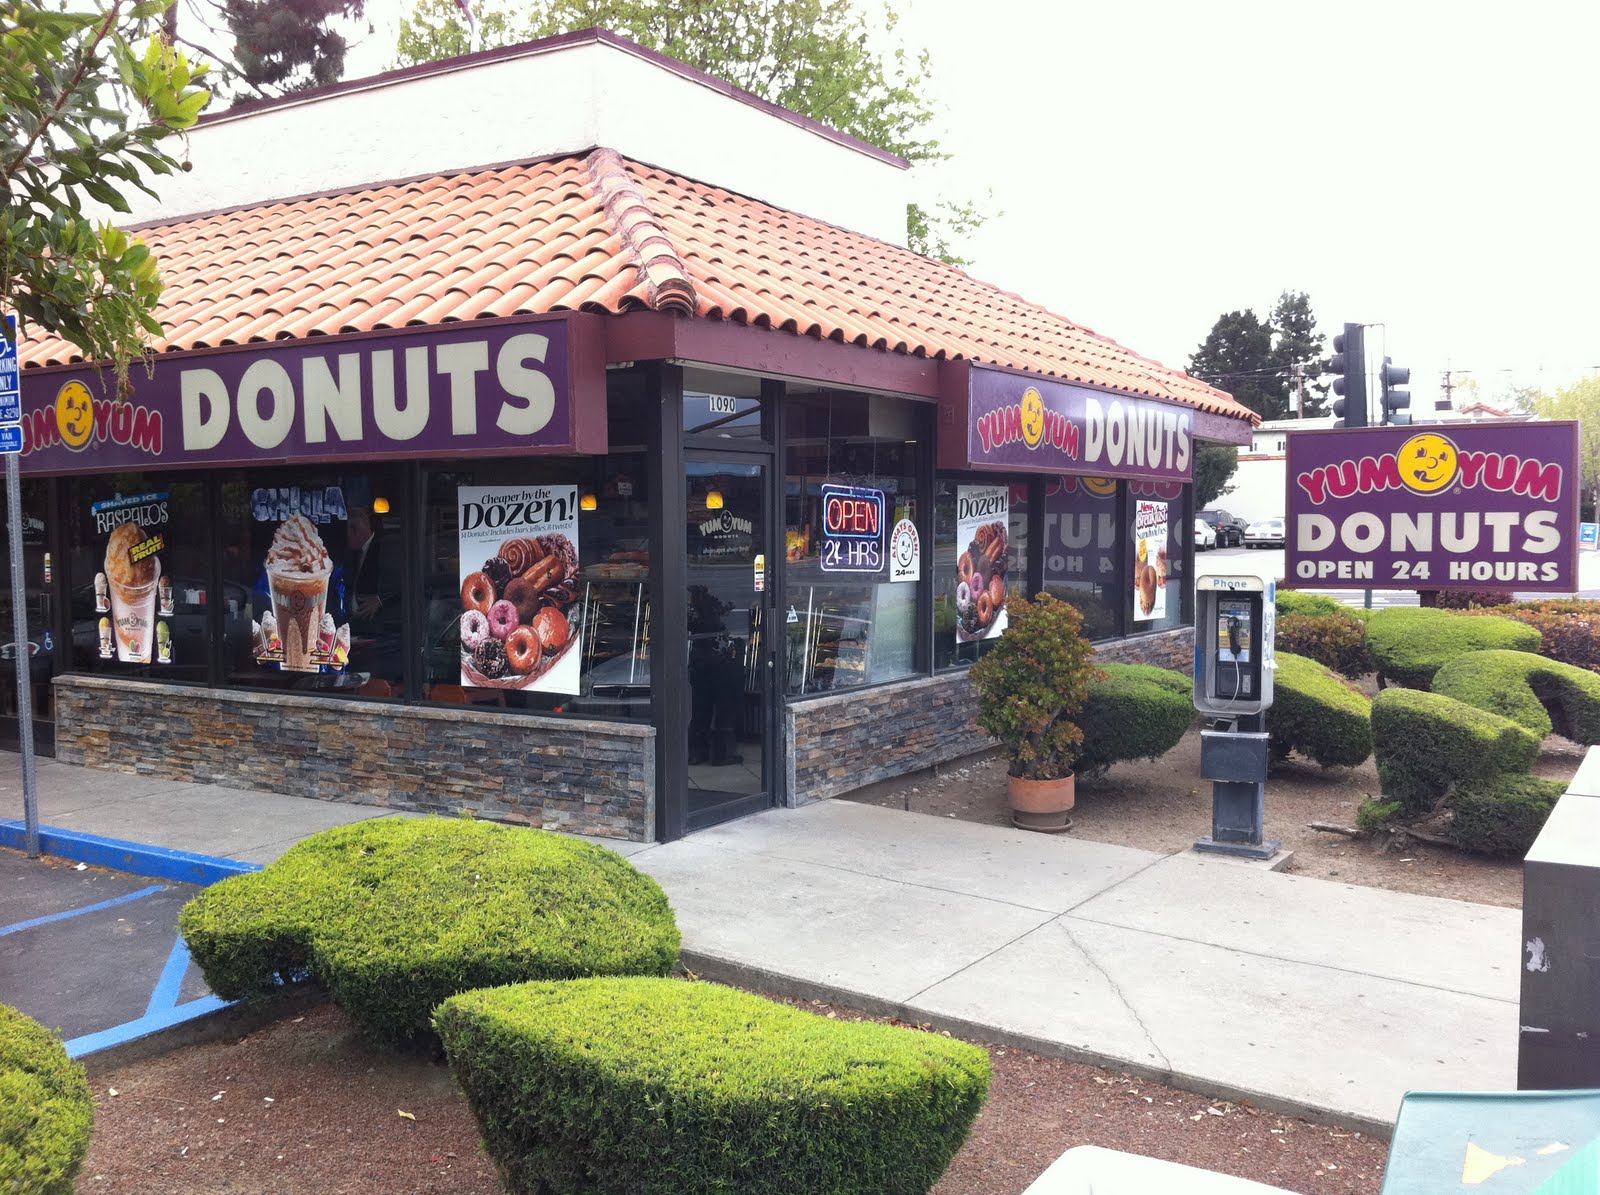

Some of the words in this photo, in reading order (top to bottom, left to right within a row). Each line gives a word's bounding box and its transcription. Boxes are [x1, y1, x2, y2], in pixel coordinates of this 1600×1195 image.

[20, 404, 62, 455] UM
[94, 400, 162, 455] YUM
[180, 333, 556, 451] DONUTS
[710, 396, 736, 412] 1090
[976, 404, 1023, 453] YUM
[1042, 407, 1079, 461] YUM
[1085, 397, 1190, 472] DONUTS
[1297, 453, 1401, 505] YUM
[1458, 450, 1563, 502] YUM
[101, 497, 140, 509] SHAVED
[481, 492, 520, 506] Cheaper
[521, 490, 534, 502] by
[535, 489, 551, 499] the
[959, 491, 1007, 520] Dozen!
[461, 491, 576, 530] Dozen!
[828, 498, 877, 533] OPEN
[700, 518, 721, 536] YUM
[732, 517, 752, 534] YUM
[1297, 511, 1561, 554] DONUTS
[132, 536, 160, 555] REAL
[133, 542, 162, 561] FRUIT
[825, 540, 843, 566] 24
[848, 541, 879, 566] HRS
[1296, 560, 1374, 580] OPEN
[1391, 561, 1430, 580] 24
[1449, 561, 1559, 582] HOURS
[1213, 579, 1248, 588] Phone
